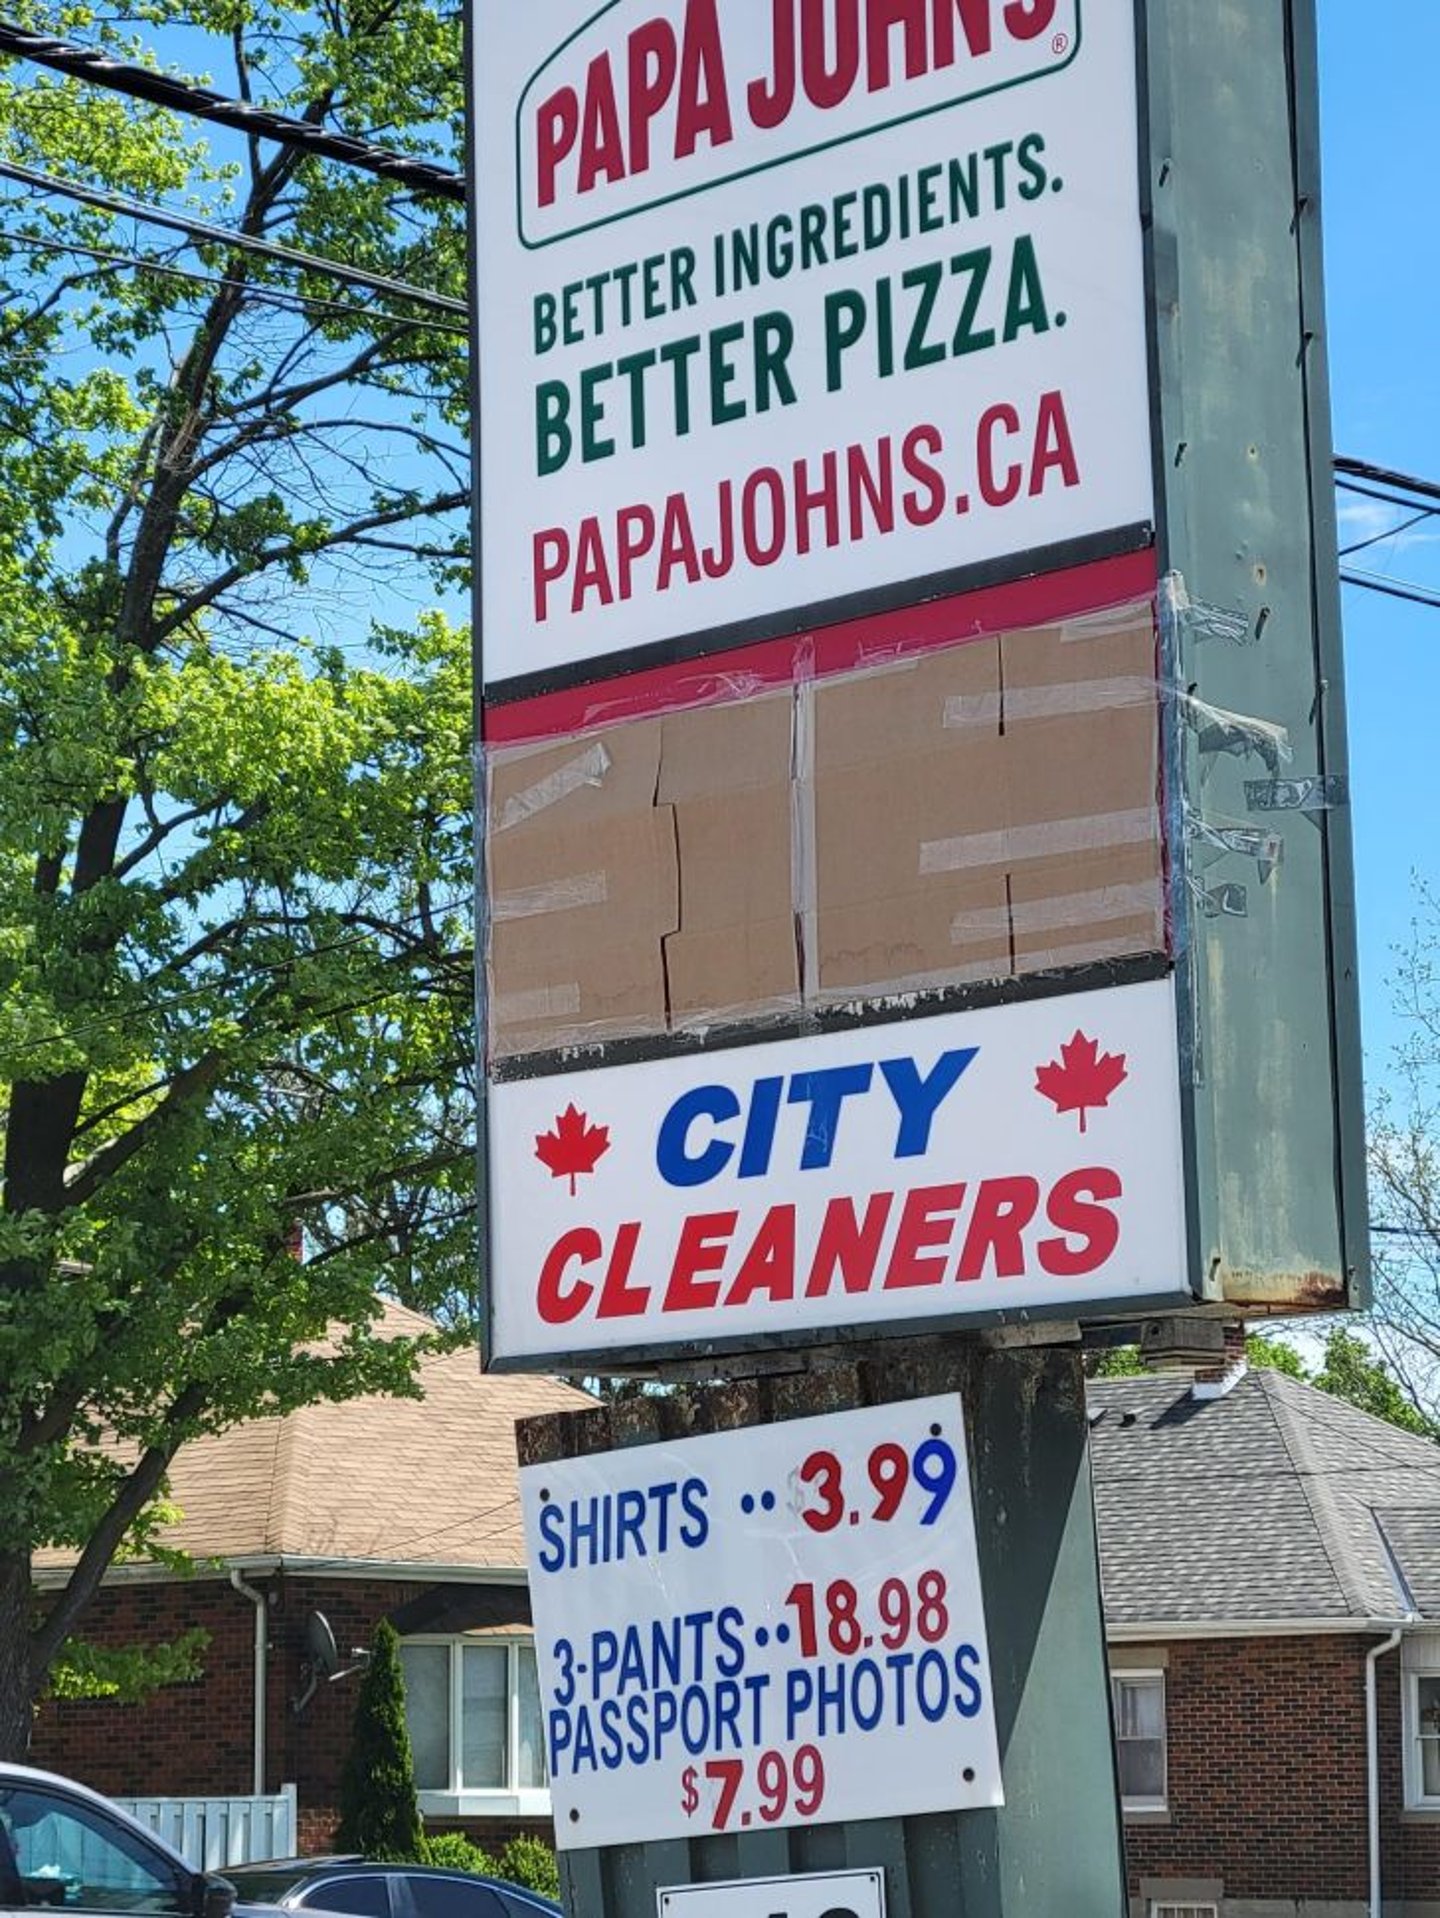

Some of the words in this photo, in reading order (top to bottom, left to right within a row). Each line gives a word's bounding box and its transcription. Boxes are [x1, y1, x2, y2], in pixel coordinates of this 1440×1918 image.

[537, 0, 733, 208] PAPA
[533, 246, 697, 355] BETTER
[714, 132, 1063, 297] INGREDIENTS.
[535, 311, 797, 477] BETTER
[824, 233, 1067, 393] PIZZA.
[532, 390, 1080, 623] PAPAJOHNS.CA
[655, 1046, 981, 1188] CITY
[536, 1166, 1123, 1325] CLEANERS
[538, 1477, 709, 1573] SHIRTS
[800, 1438, 957, 1533] 3.99
[549, 1674, 770, 1778] PASSPORT
[786, 1643, 982, 1740] PHOTOS
[680, 1744, 826, 1831] $7.99
